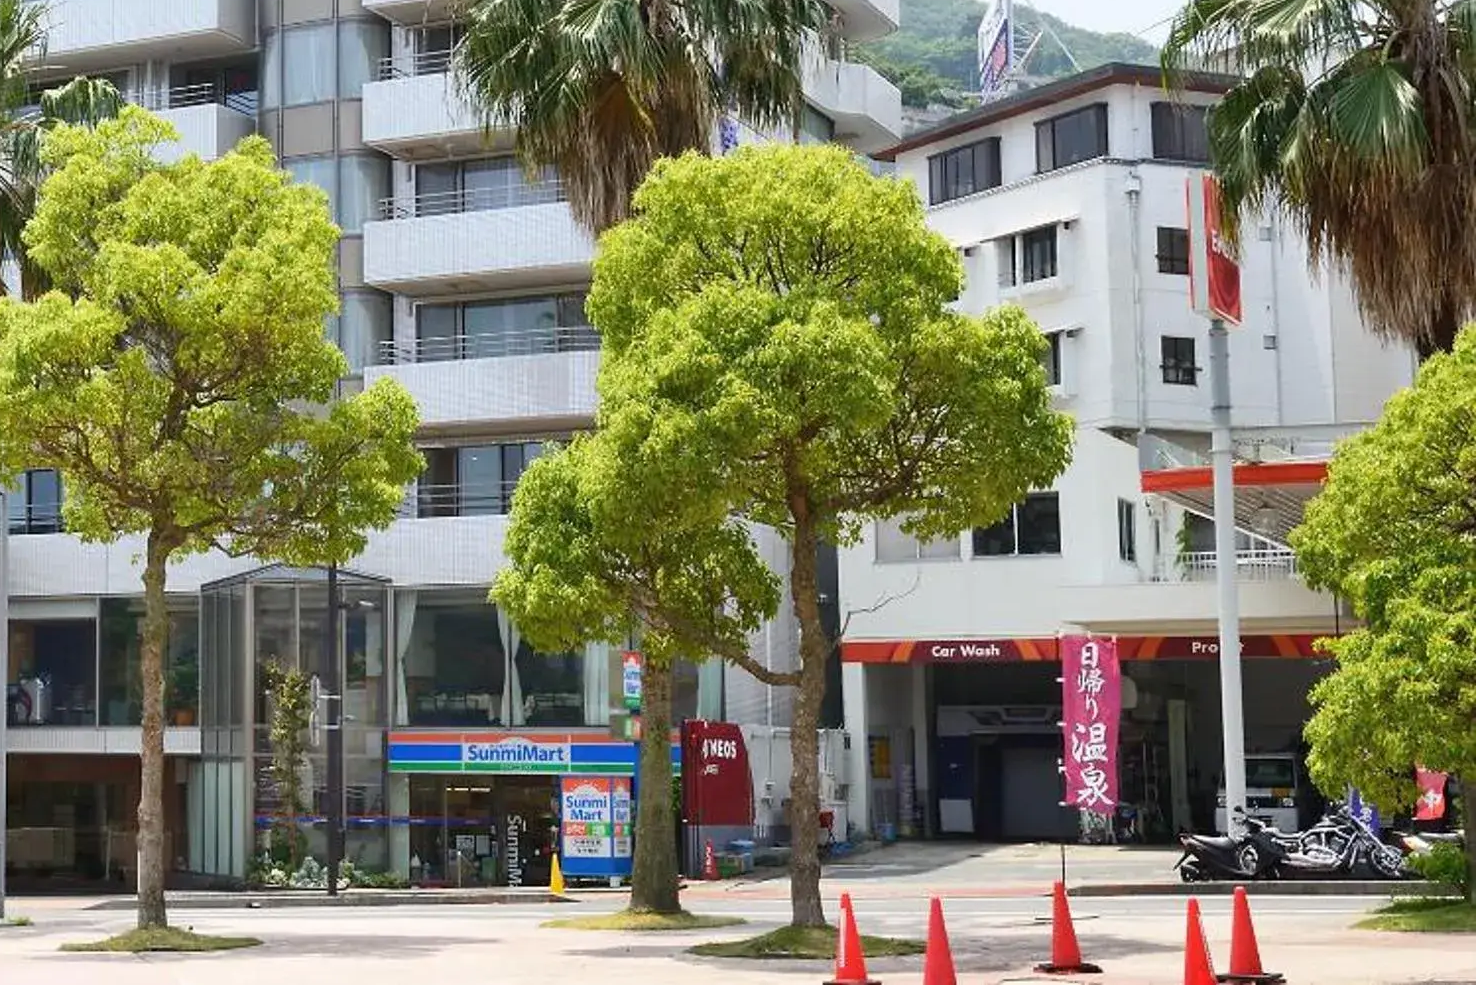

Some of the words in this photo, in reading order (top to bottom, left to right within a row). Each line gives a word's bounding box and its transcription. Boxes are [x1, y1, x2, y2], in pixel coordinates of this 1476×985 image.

[932, 645, 955, 657] Car
[960, 644, 1000, 657] Wash
[1071, 641, 1115, 806] 日帰り温泉
[467, 743, 564, 761] SunmiMart
[566, 796, 607, 808] Sunmi
[570, 809, 603, 821] Mart
